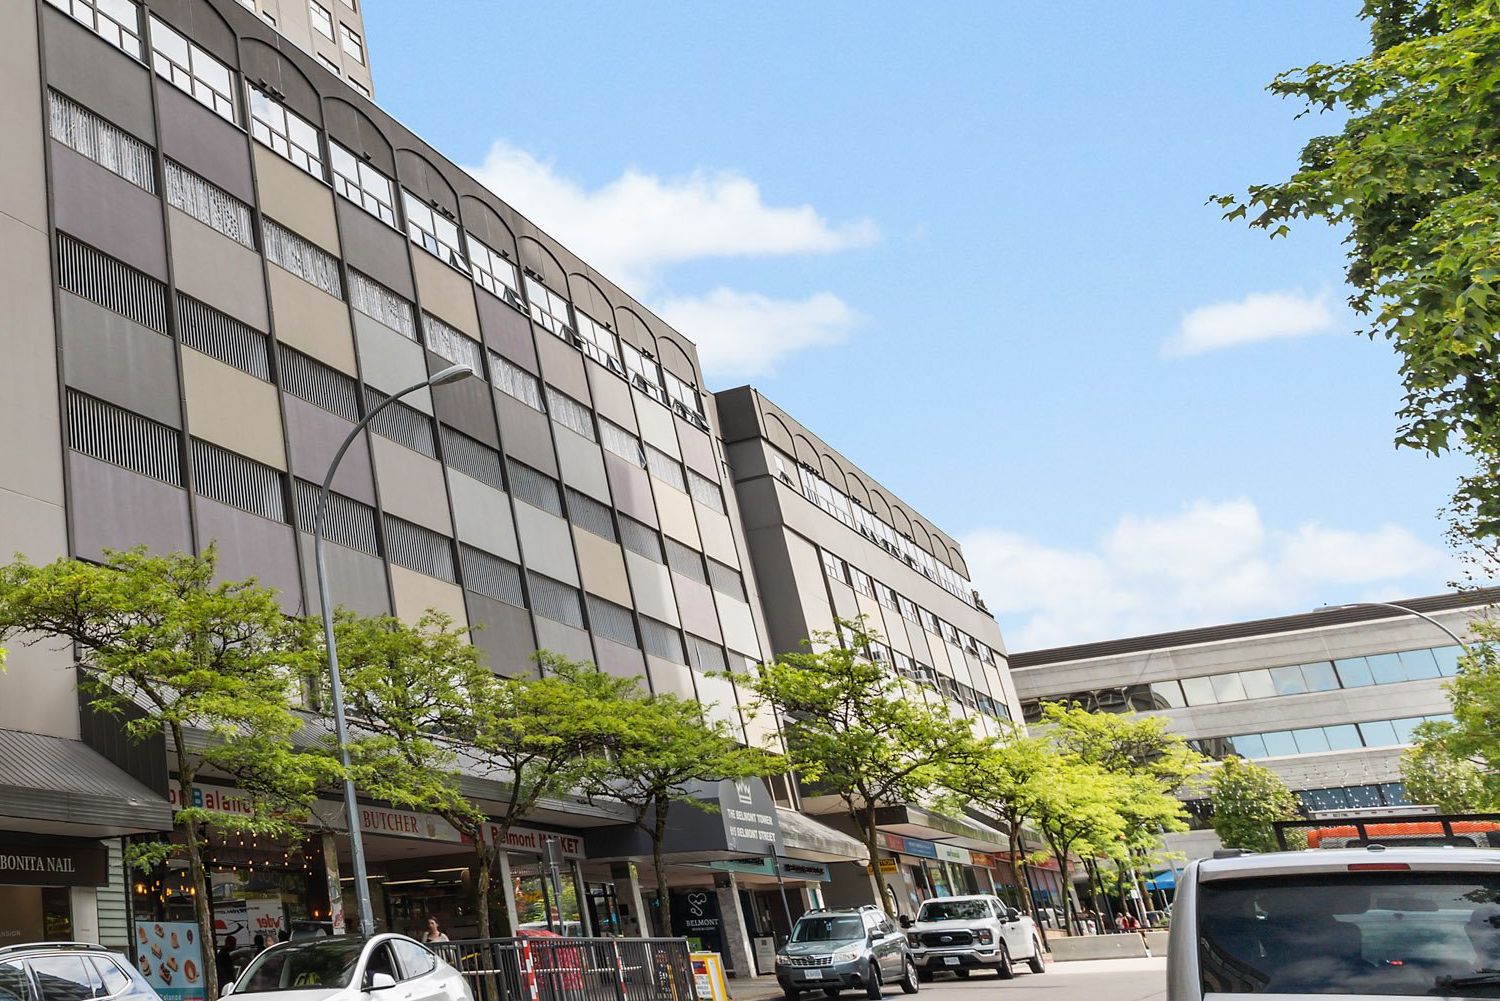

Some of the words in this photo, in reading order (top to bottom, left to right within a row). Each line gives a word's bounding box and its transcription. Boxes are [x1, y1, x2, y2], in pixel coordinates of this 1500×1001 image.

[191, 787, 252, 813] Balanc
[363, 810, 418, 833] BUTCHER
[736, 810, 757, 823] BELMONT
[756, 813, 774, 826] TOWER
[736, 827, 759, 839] BELMONT
[0, 854, 46, 871] BONITA
[46, 857, 76, 873] NAIL
[686, 918, 719, 927] BELMONT
